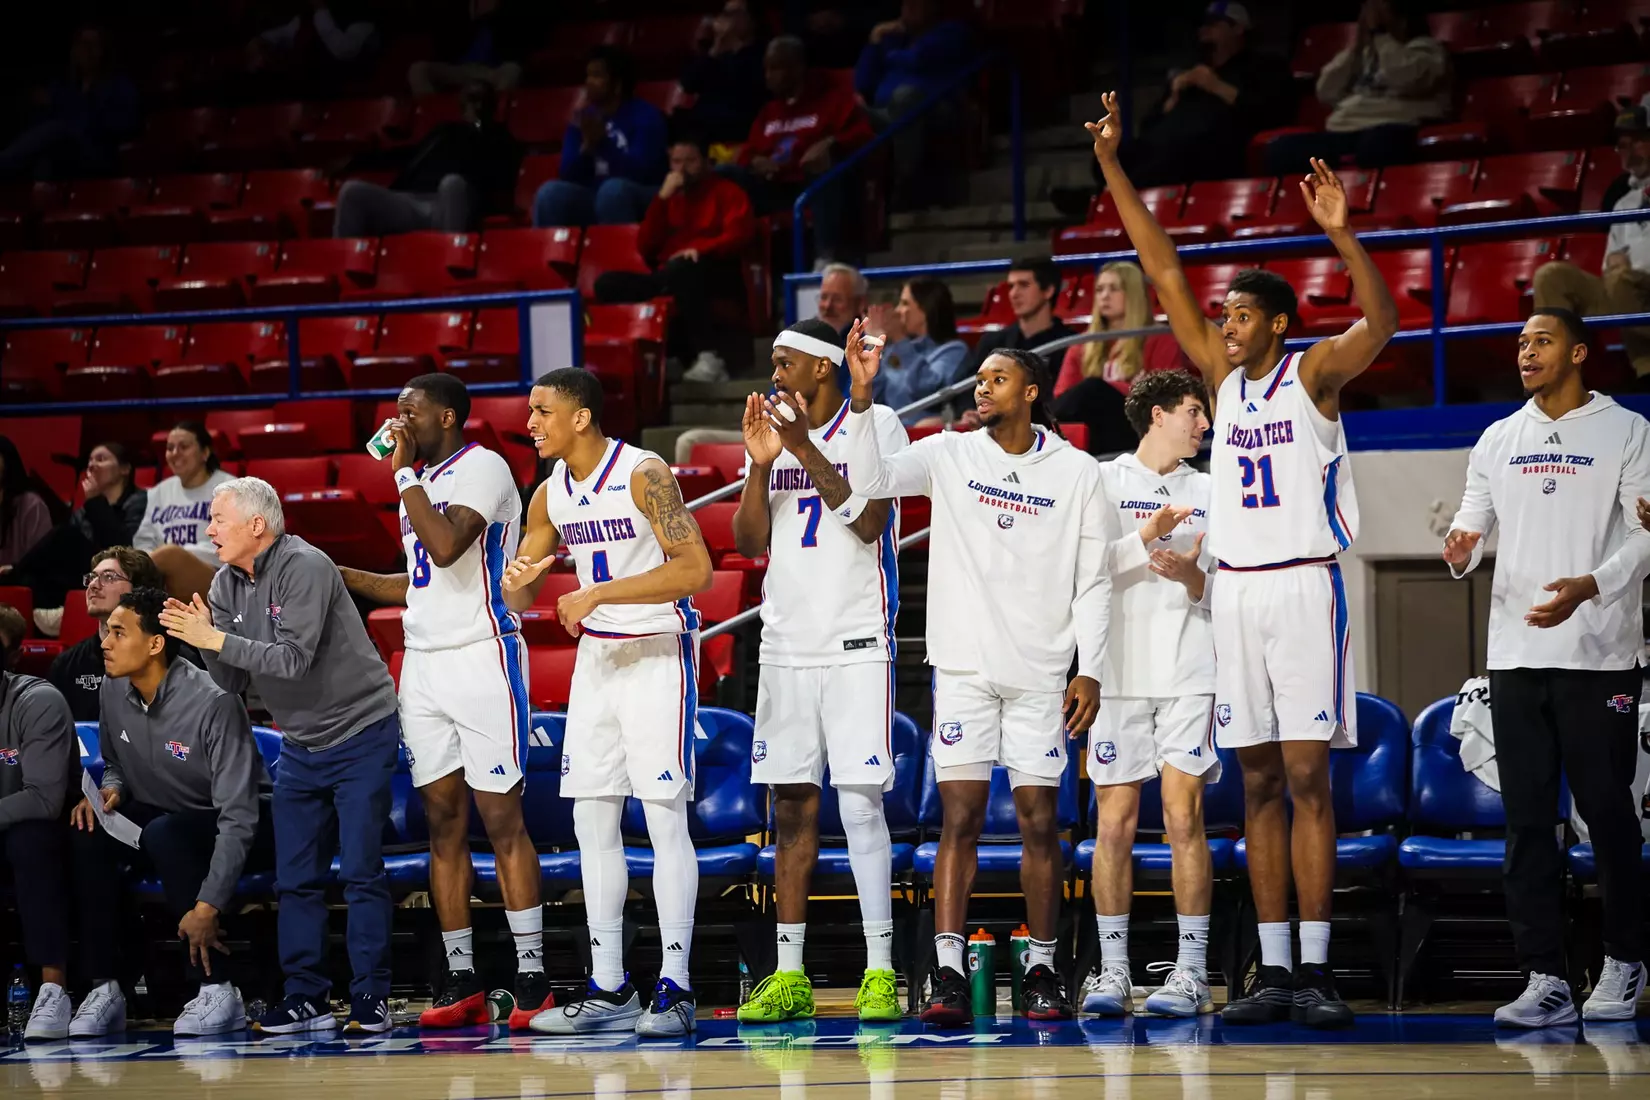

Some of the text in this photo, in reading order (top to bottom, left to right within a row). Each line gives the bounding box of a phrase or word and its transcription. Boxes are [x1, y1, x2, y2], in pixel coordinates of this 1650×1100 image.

[1264, 420, 1294, 446] TECH
[1508, 453, 1594, 467] LOUISIANA TECH
[1522, 464, 1577, 475] BASKETBALL
[968, 480, 1056, 508] LOUISIANA TECH
[1238, 454, 1280, 509] 21
[979, 495, 1039, 516] BASKETBALL
[163, 524, 198, 546] TECH
[603, 518, 637, 541] TECH
[797, 495, 822, 549] 7
[413, 540, 431, 589] 8
[592, 550, 613, 583] 4
